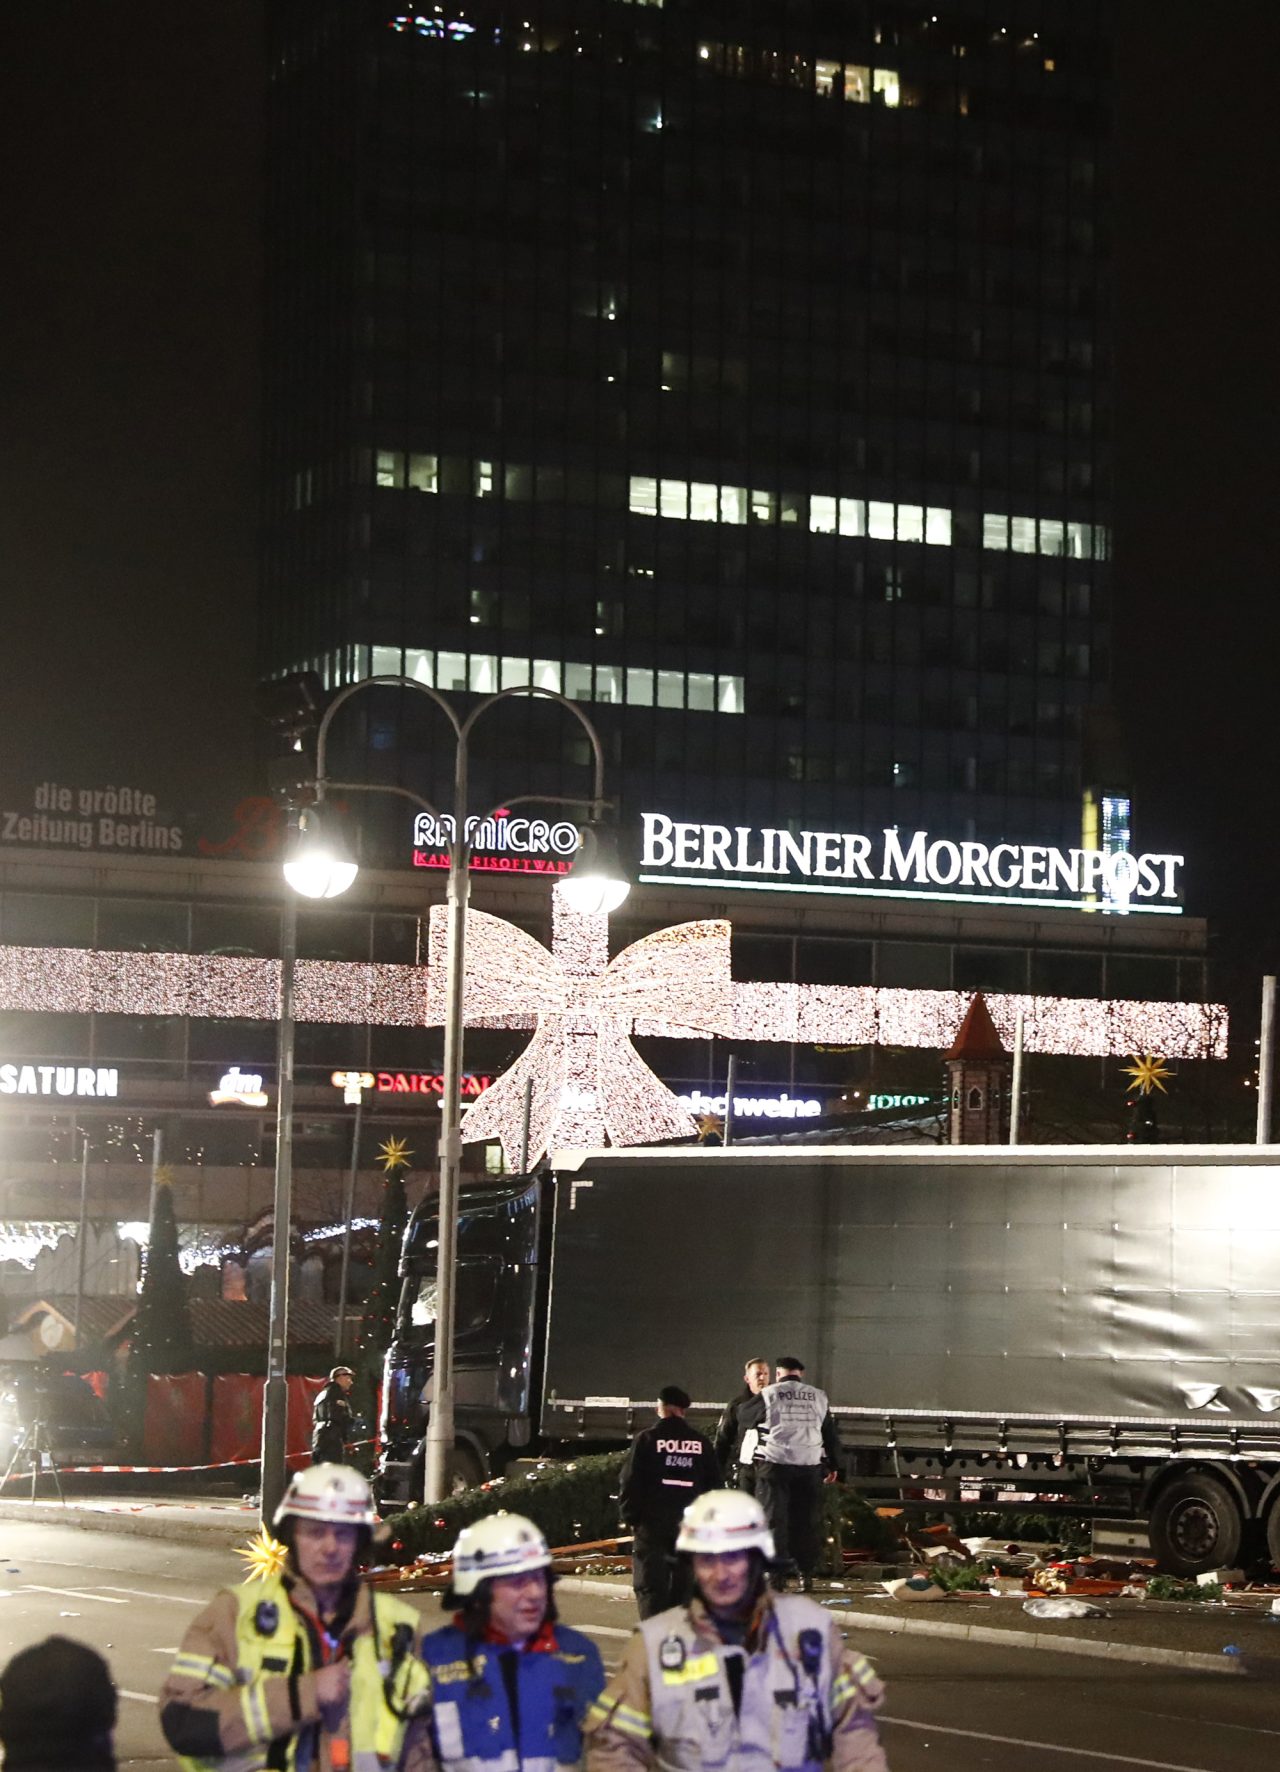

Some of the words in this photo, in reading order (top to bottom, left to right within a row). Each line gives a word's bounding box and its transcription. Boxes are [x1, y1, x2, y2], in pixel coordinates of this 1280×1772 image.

[35, 782, 72, 811] die
[2, 812, 93, 848] Zeitung
[99, 818, 182, 850] Berlins
[640, 812, 875, 880] BERLINER
[880, 828, 1185, 898] MORGENPOST
[0, 1064, 119, 1097] SATURN
[219, 1067, 262, 1093] dm
[778, 1391, 816, 1401] POLIZEI
[656, 1439, 702, 1455] POLIZEI
